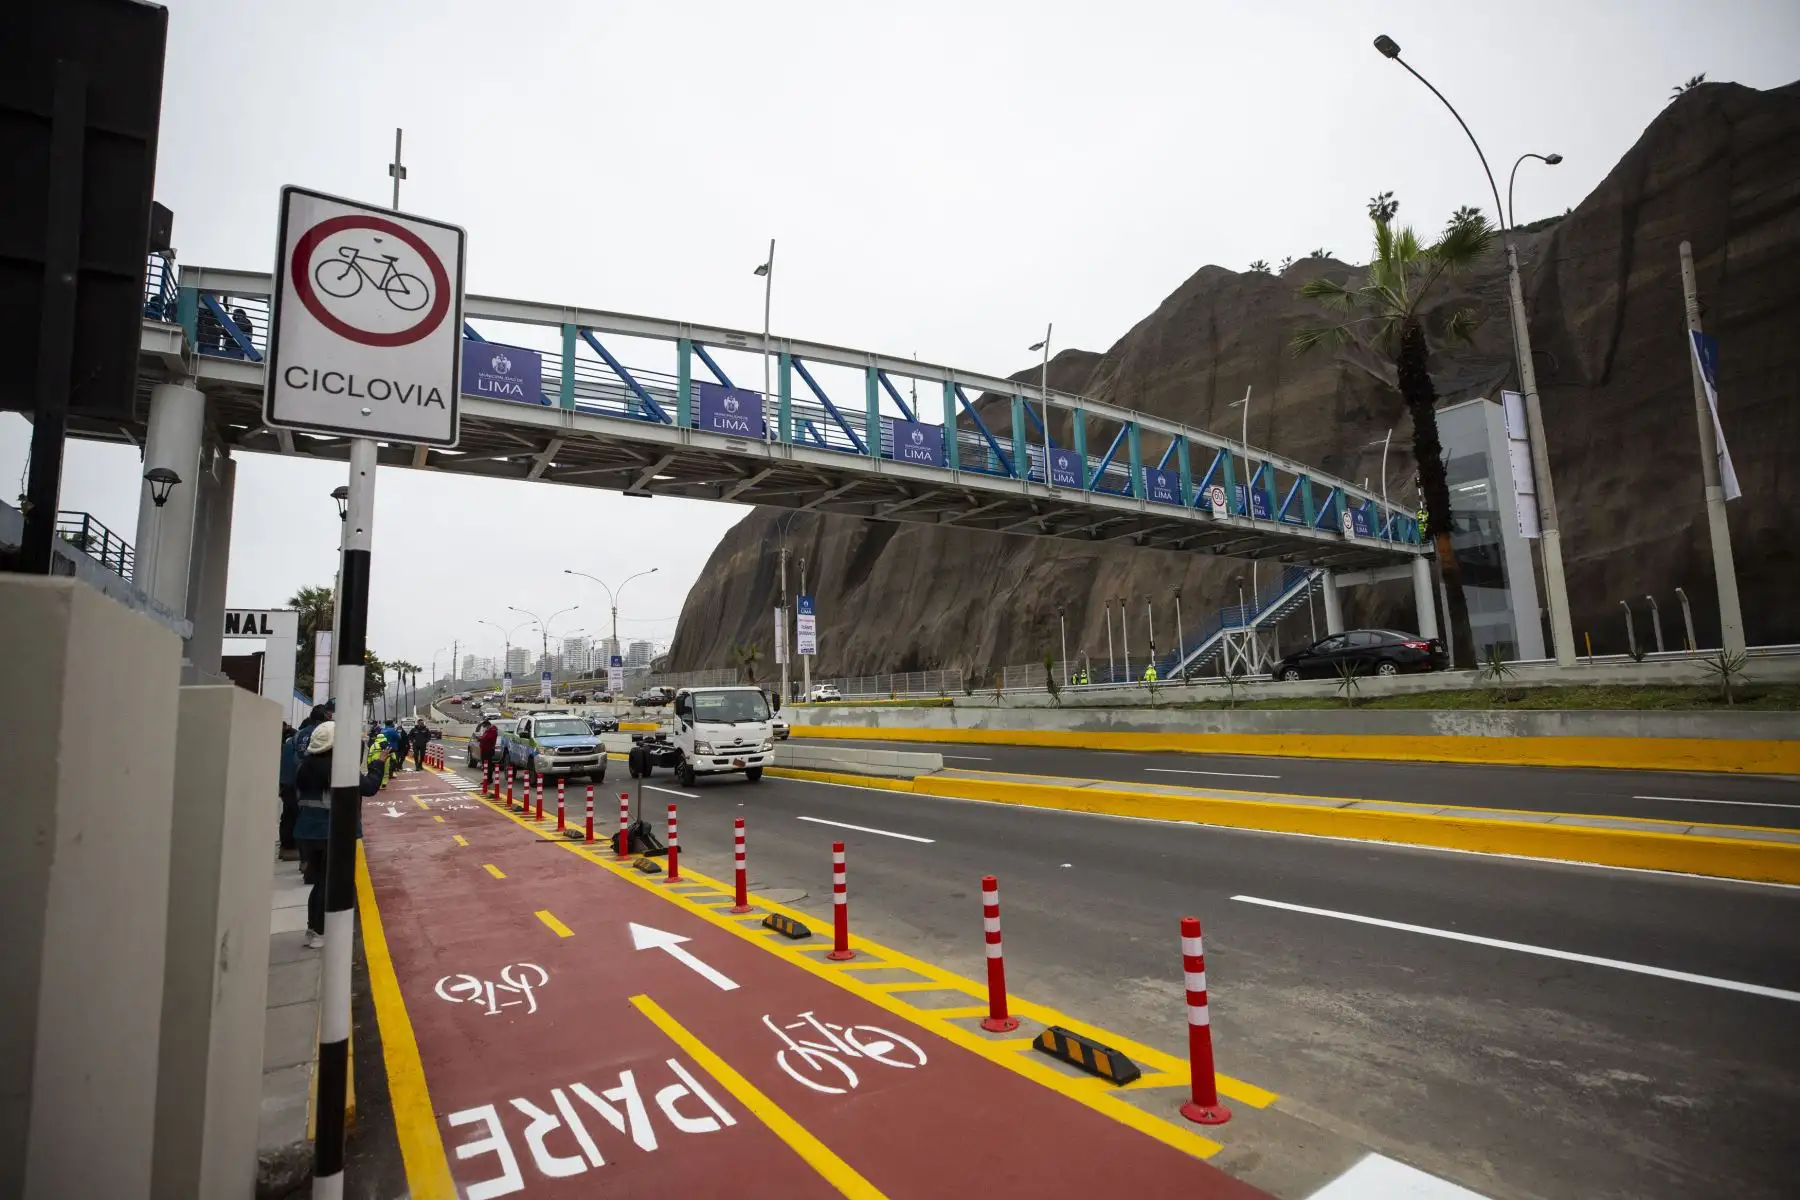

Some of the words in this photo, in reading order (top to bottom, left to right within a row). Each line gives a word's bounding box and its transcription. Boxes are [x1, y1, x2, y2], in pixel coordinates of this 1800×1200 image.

[284, 365, 446, 410] CICLOVIA
[478, 379, 524, 397] LIMA
[713, 417, 749, 432] LIMA
[904, 448, 932, 461] LIMA
[1053, 473, 1075, 485] LIMA
[1154, 490, 1172, 501] LIMA
[1356, 525, 1368, 533] LIMA
[448, 1058, 738, 1200] PARE
